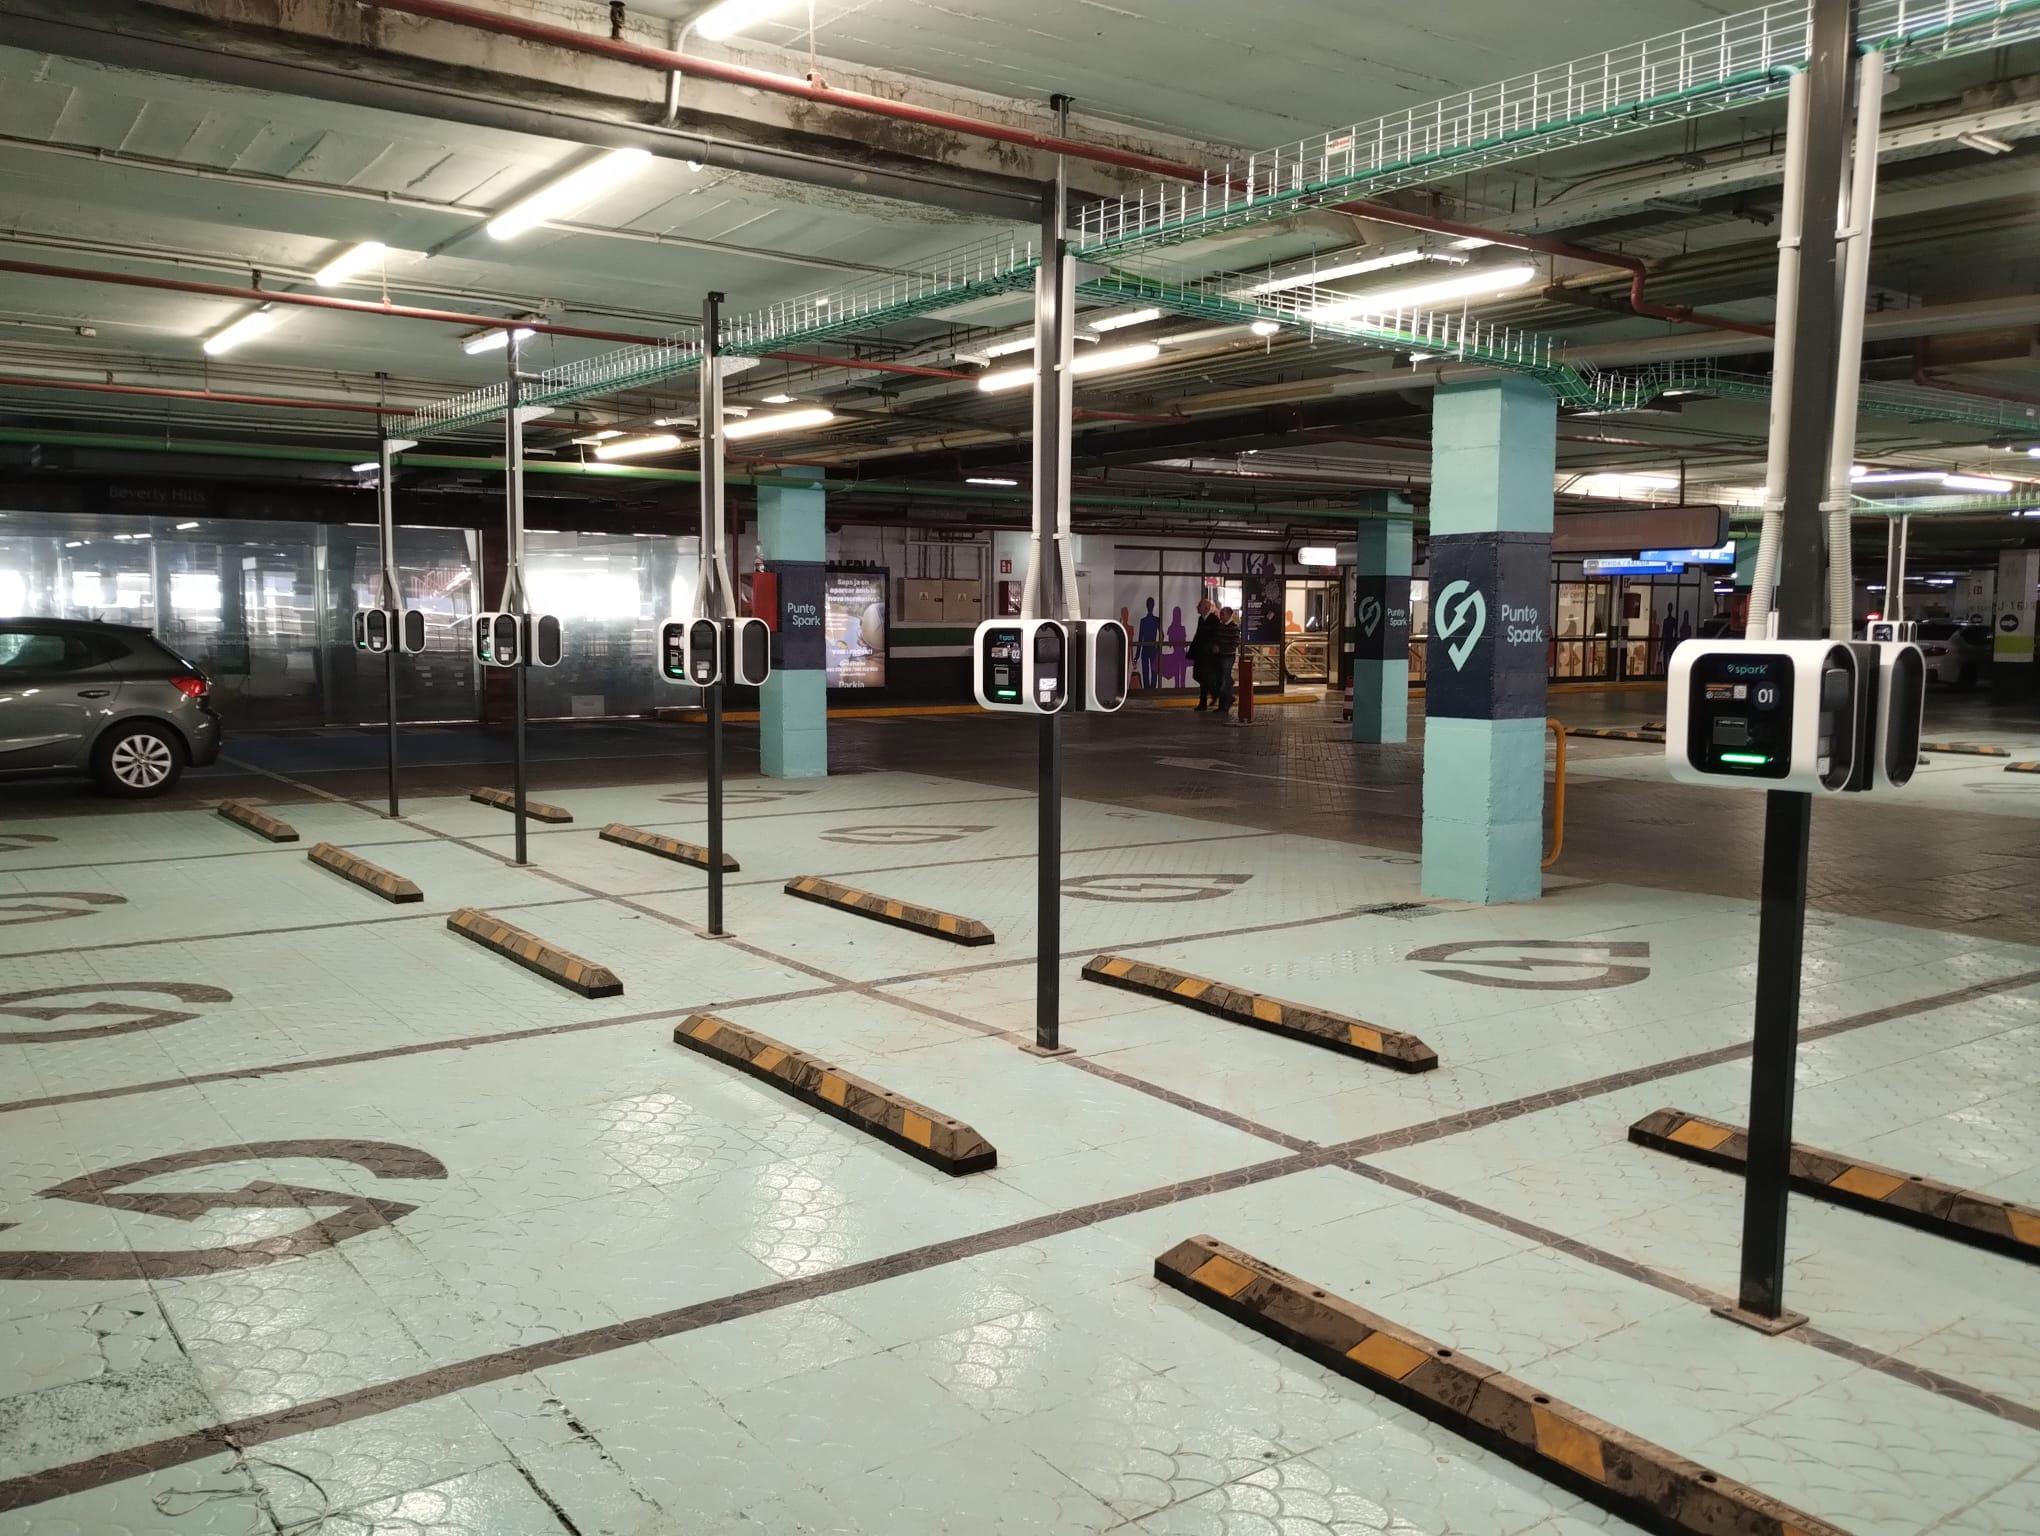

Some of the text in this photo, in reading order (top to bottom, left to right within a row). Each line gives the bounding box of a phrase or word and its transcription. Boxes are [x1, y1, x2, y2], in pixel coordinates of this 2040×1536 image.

[109, 487, 206, 503] Beverly Hills
[787, 602, 816, 616] Punto
[1387, 608, 1405, 618] Punto
[1501, 604, 1538, 624] Punto
[792, 615, 821, 628] Spark
[1390, 617, 1408, 627] Spark
[1507, 625, 1543, 647] Spark
[1011, 649, 1021, 659] 02
[1734, 664, 1769, 675] spark
[1757, 688, 1775, 704] 01
